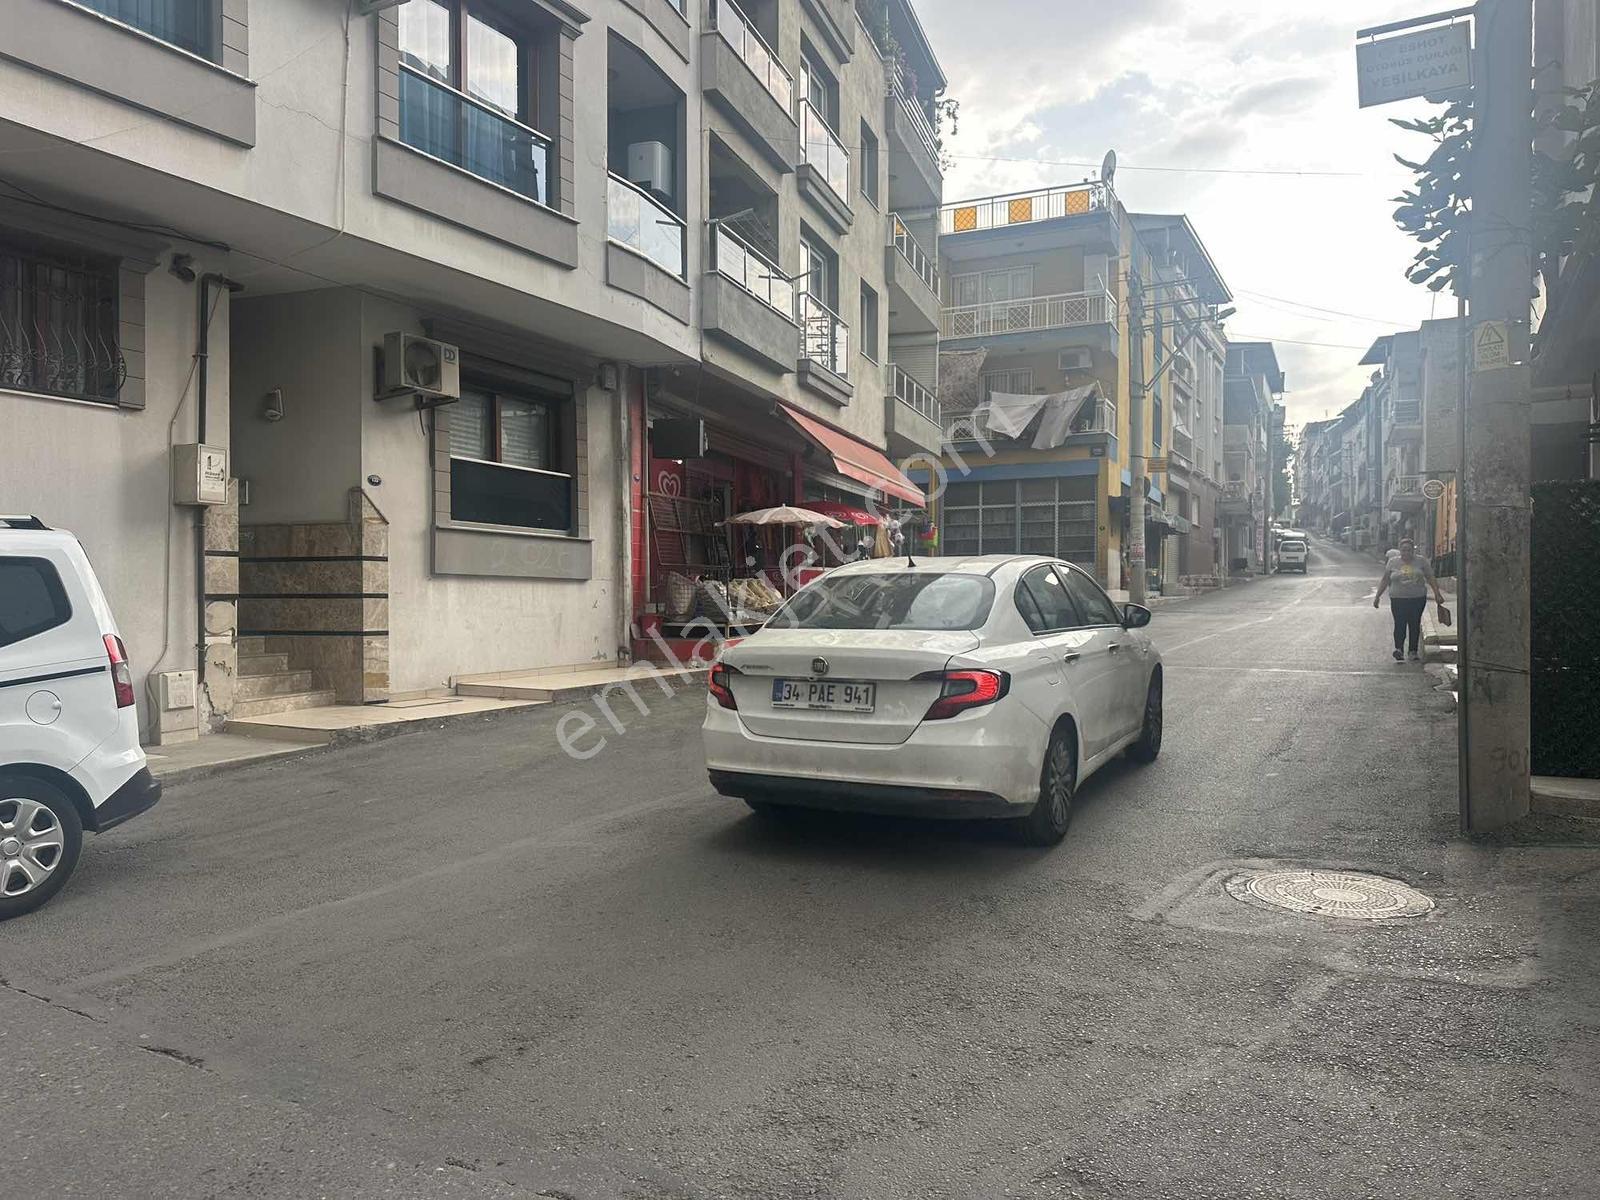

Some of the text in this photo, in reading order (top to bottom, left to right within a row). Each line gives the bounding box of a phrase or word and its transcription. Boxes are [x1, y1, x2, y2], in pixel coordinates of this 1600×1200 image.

[1400, 36, 1446, 53] ESHOT
[784, 684, 800, 701] 34
[808, 684, 836, 703] PAE
[844, 686, 870, 705] 941
